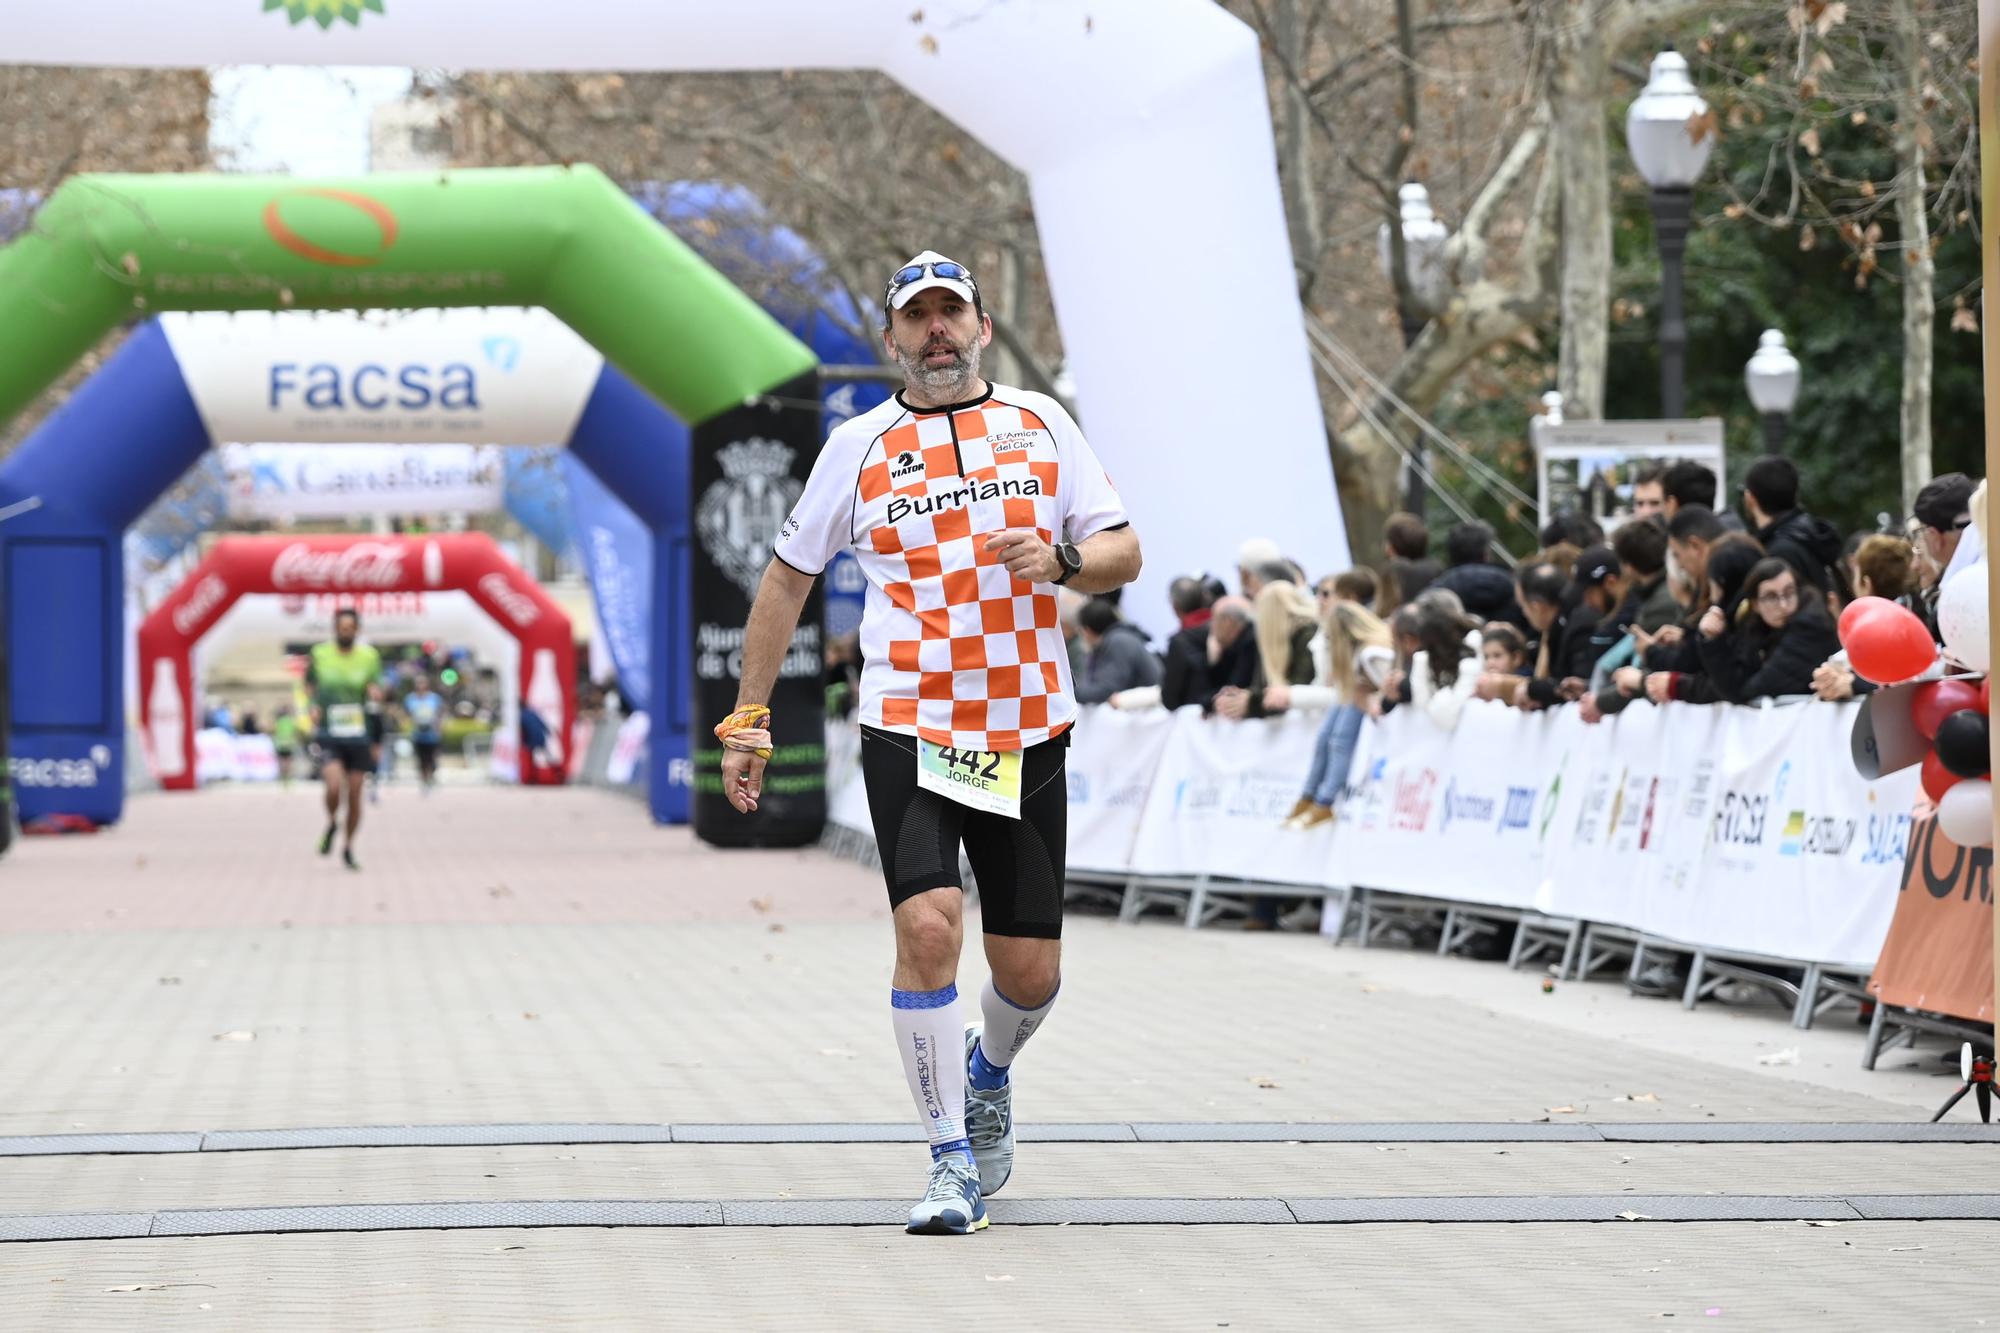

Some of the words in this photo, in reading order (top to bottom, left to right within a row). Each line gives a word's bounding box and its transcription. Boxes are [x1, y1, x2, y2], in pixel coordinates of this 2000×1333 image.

[996, 443, 1012, 452] del
[1013, 441, 1035, 449] Clot
[891, 463, 925, 478] VIATOR
[887, 479, 1040, 524] Burriana
[938, 746, 1000, 781] 442
[945, 770, 990, 791] JORGE
